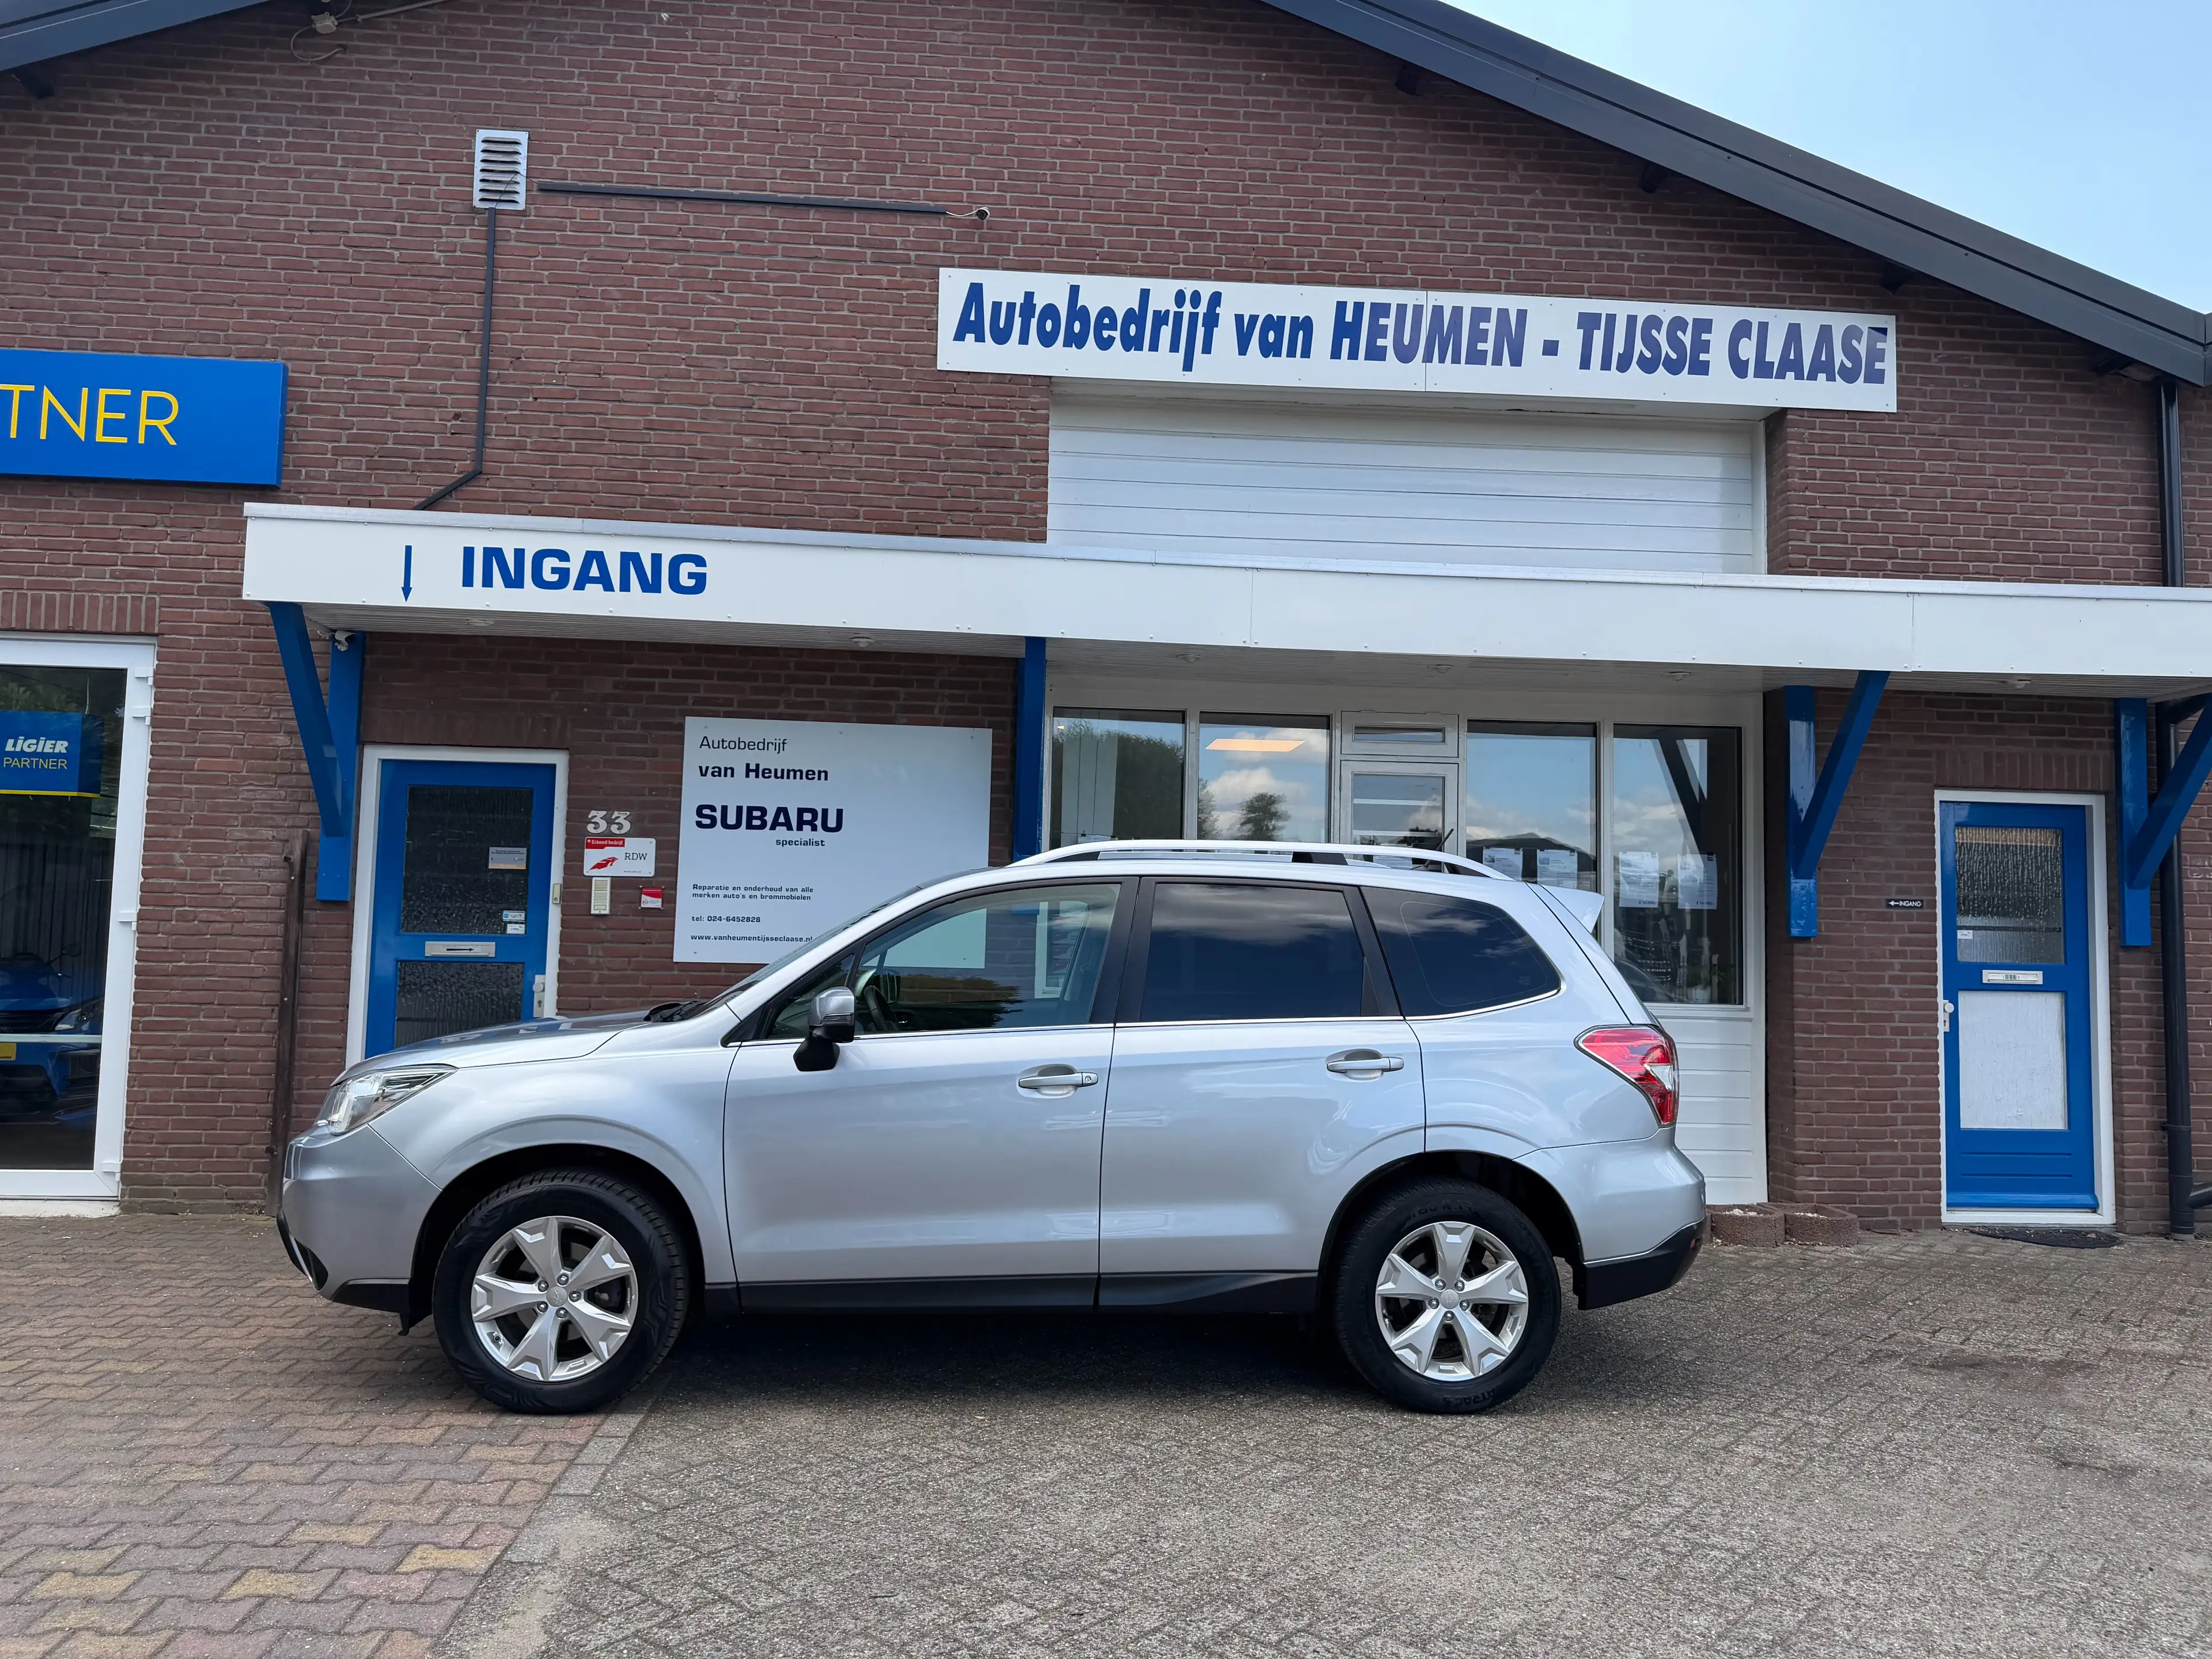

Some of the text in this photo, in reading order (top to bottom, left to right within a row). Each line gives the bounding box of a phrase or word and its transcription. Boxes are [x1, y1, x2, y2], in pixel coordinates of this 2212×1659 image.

[953, 282, 1888, 385] Autobedrijf van HEUMEN - TIJSSE CLAASE
[0, 384, 179, 445] TNER
[462, 546, 707, 595] INGANG
[699, 736, 787, 754] Autobedrijf
[3, 757, 67, 770] PARTNER
[699, 763, 828, 781] van Heumen
[586, 810, 631, 835] 33
[695, 804, 843, 833] SUBARU
[775, 838, 825, 847] specialist
[624, 853, 647, 861] RDW
